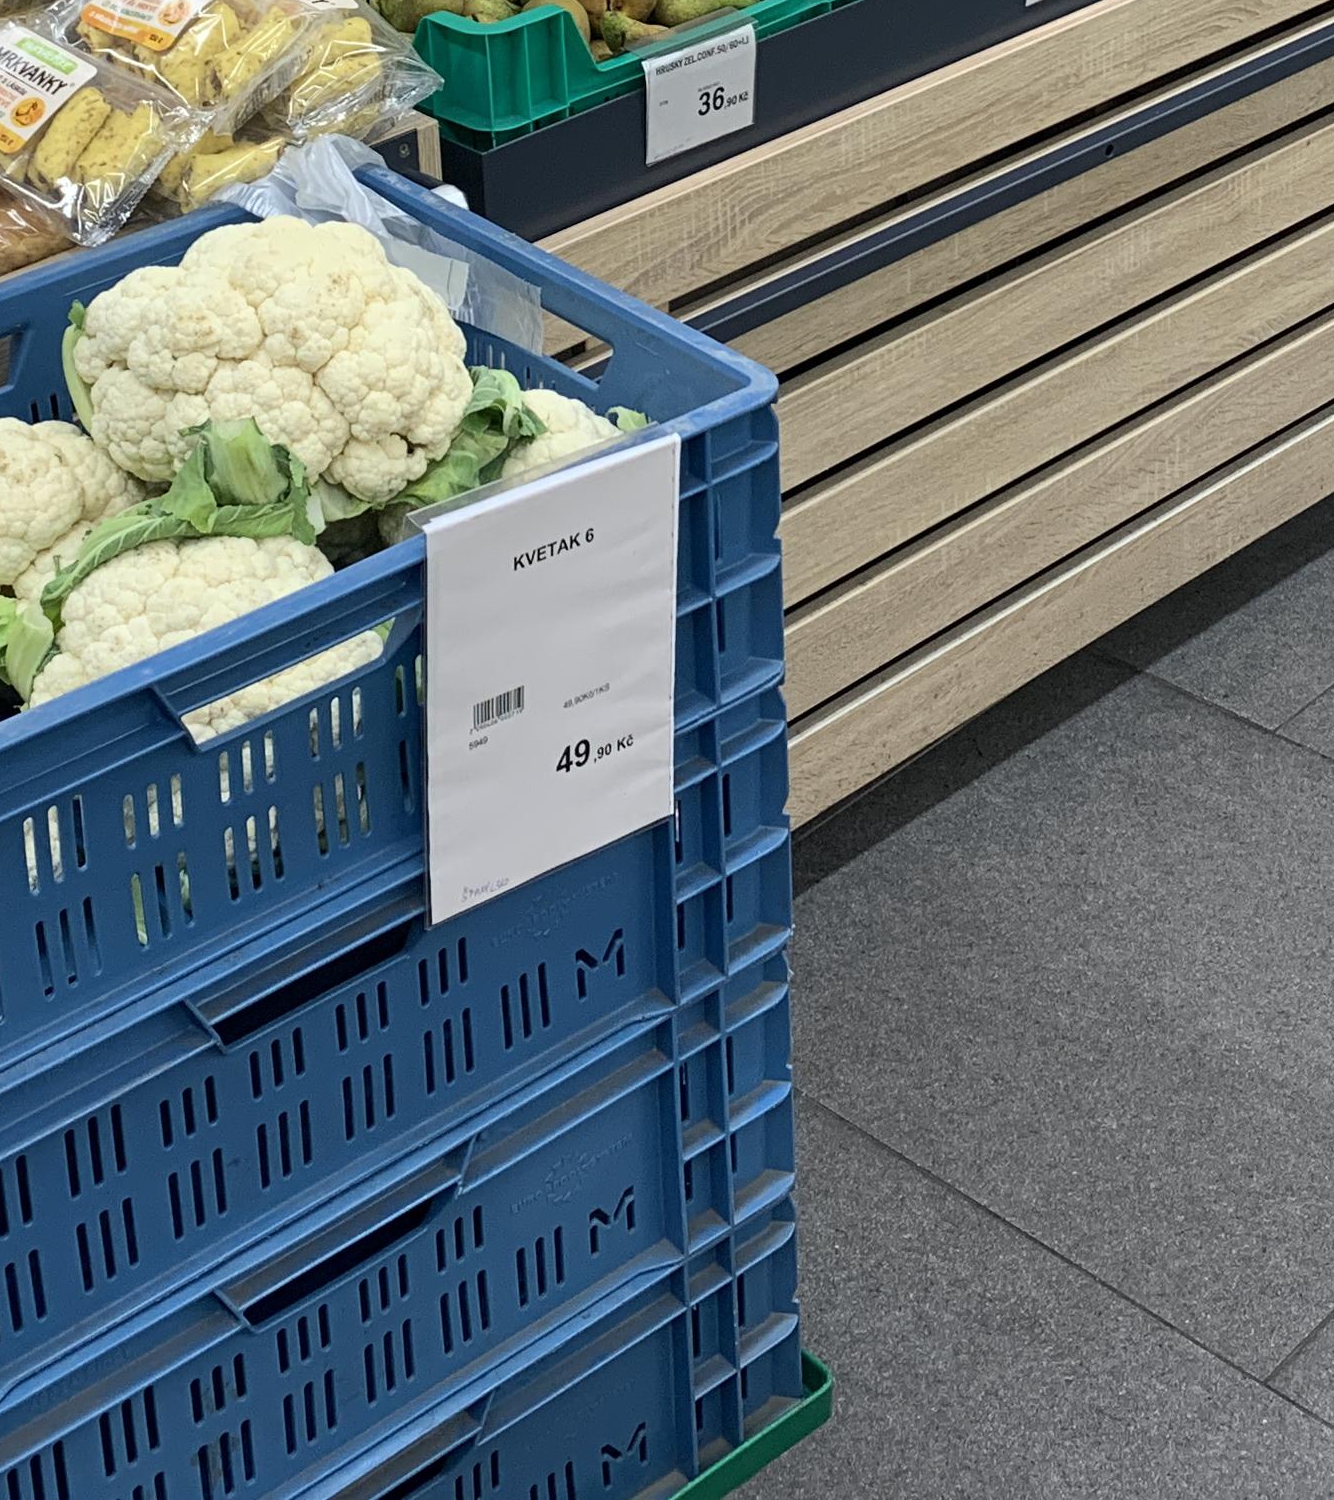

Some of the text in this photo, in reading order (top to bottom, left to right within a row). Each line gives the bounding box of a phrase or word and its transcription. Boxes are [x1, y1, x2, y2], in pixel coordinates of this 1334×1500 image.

[655, 60, 683, 76] HRUSKY
[698, 86, 749, 117] 36,90 Kč
[513, 527, 595, 571] KVETAK 6
[468, 735, 489, 751] 5949
[556, 733, 635, 773] 49,90 Kč
